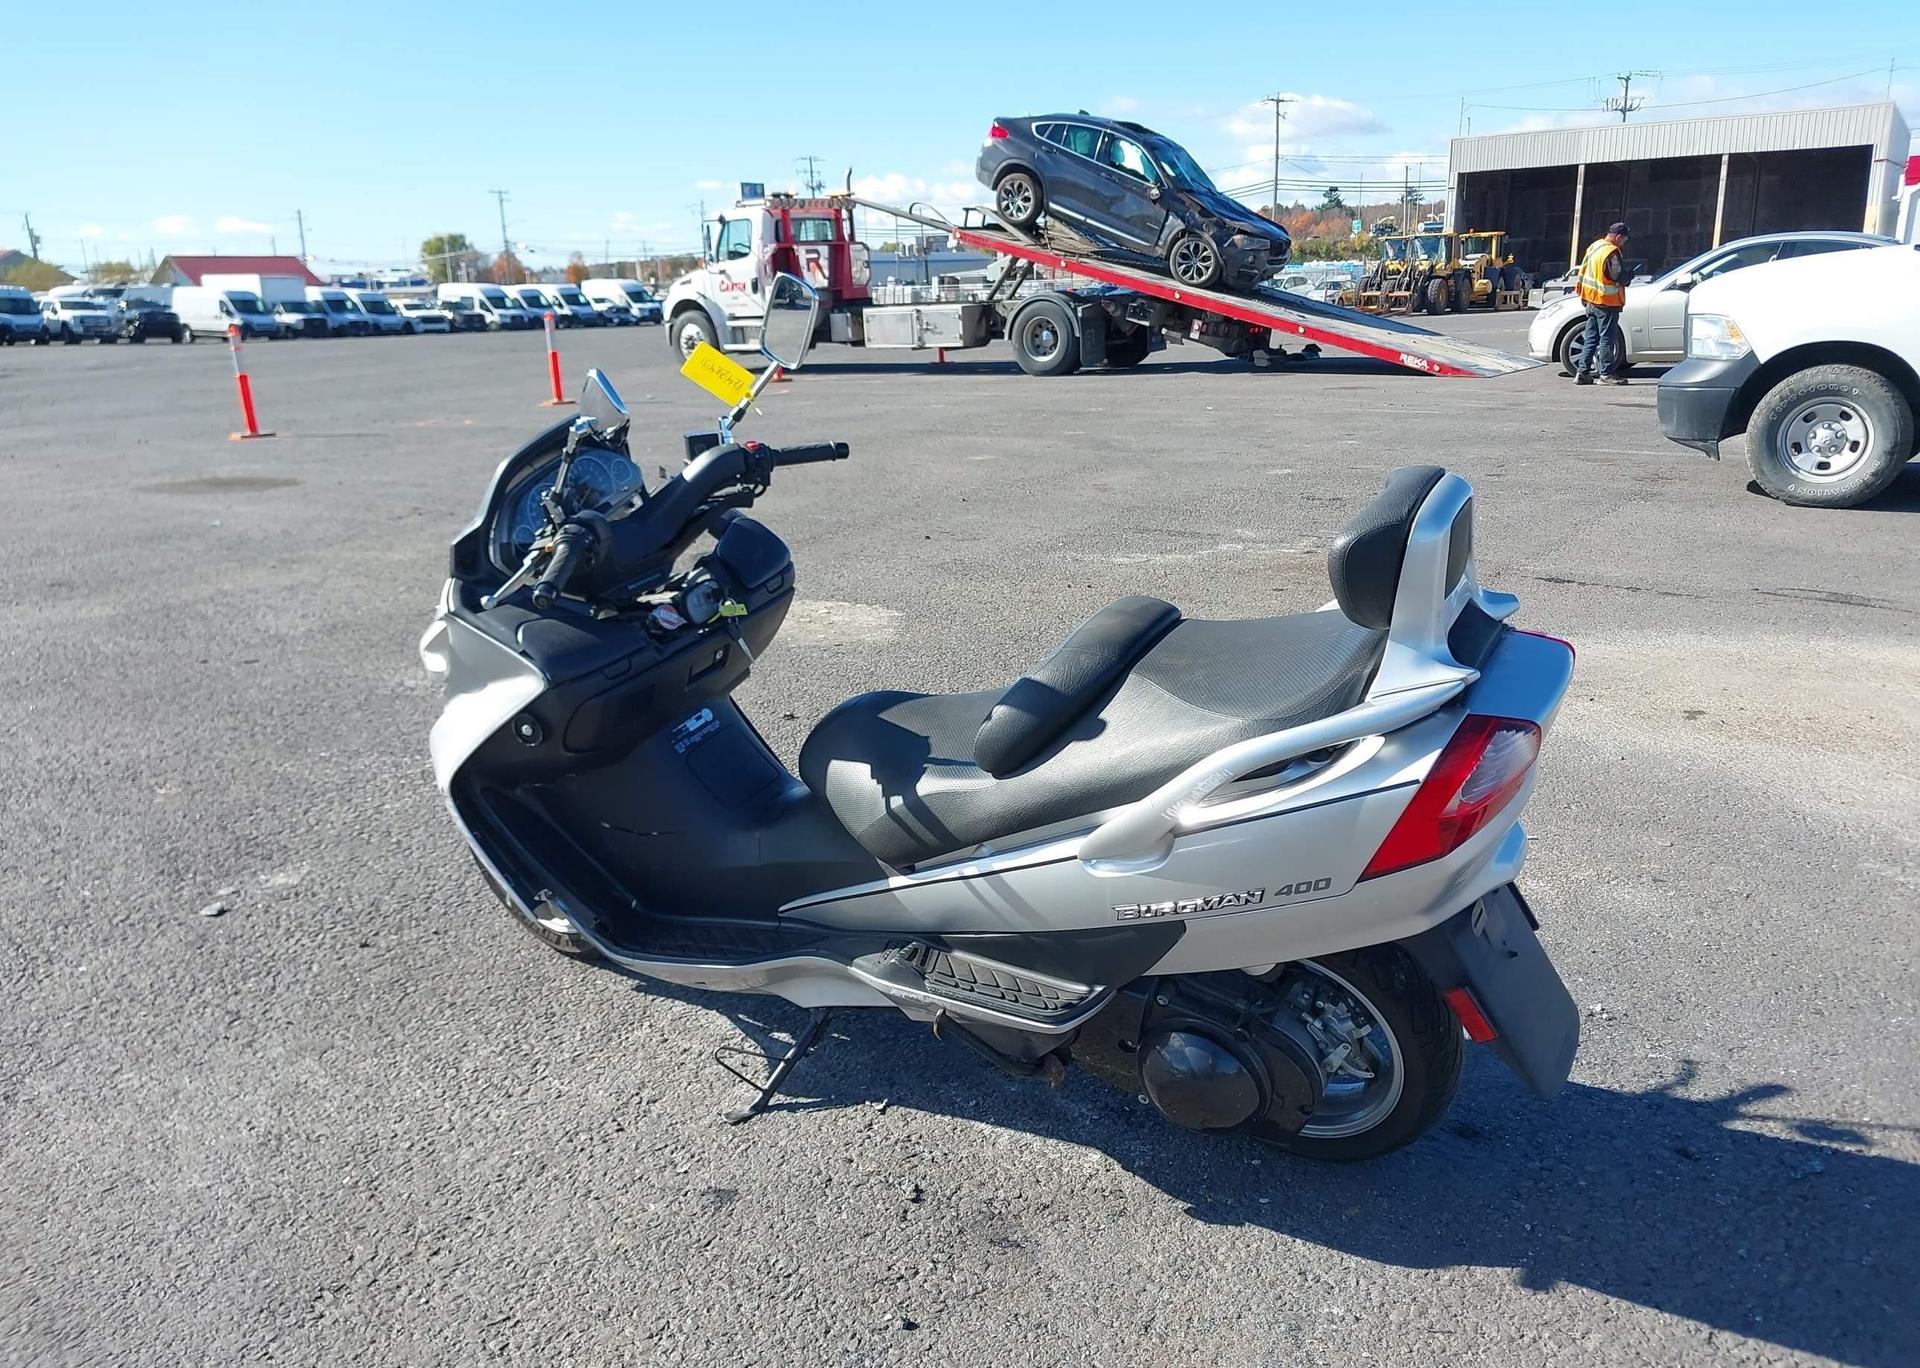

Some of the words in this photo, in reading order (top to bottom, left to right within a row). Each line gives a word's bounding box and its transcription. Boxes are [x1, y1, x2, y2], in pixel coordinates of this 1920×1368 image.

[1400, 353, 1428, 367] REKA
[1111, 887, 1265, 920] BURGMAN
[1274, 877, 1332, 897] 400
